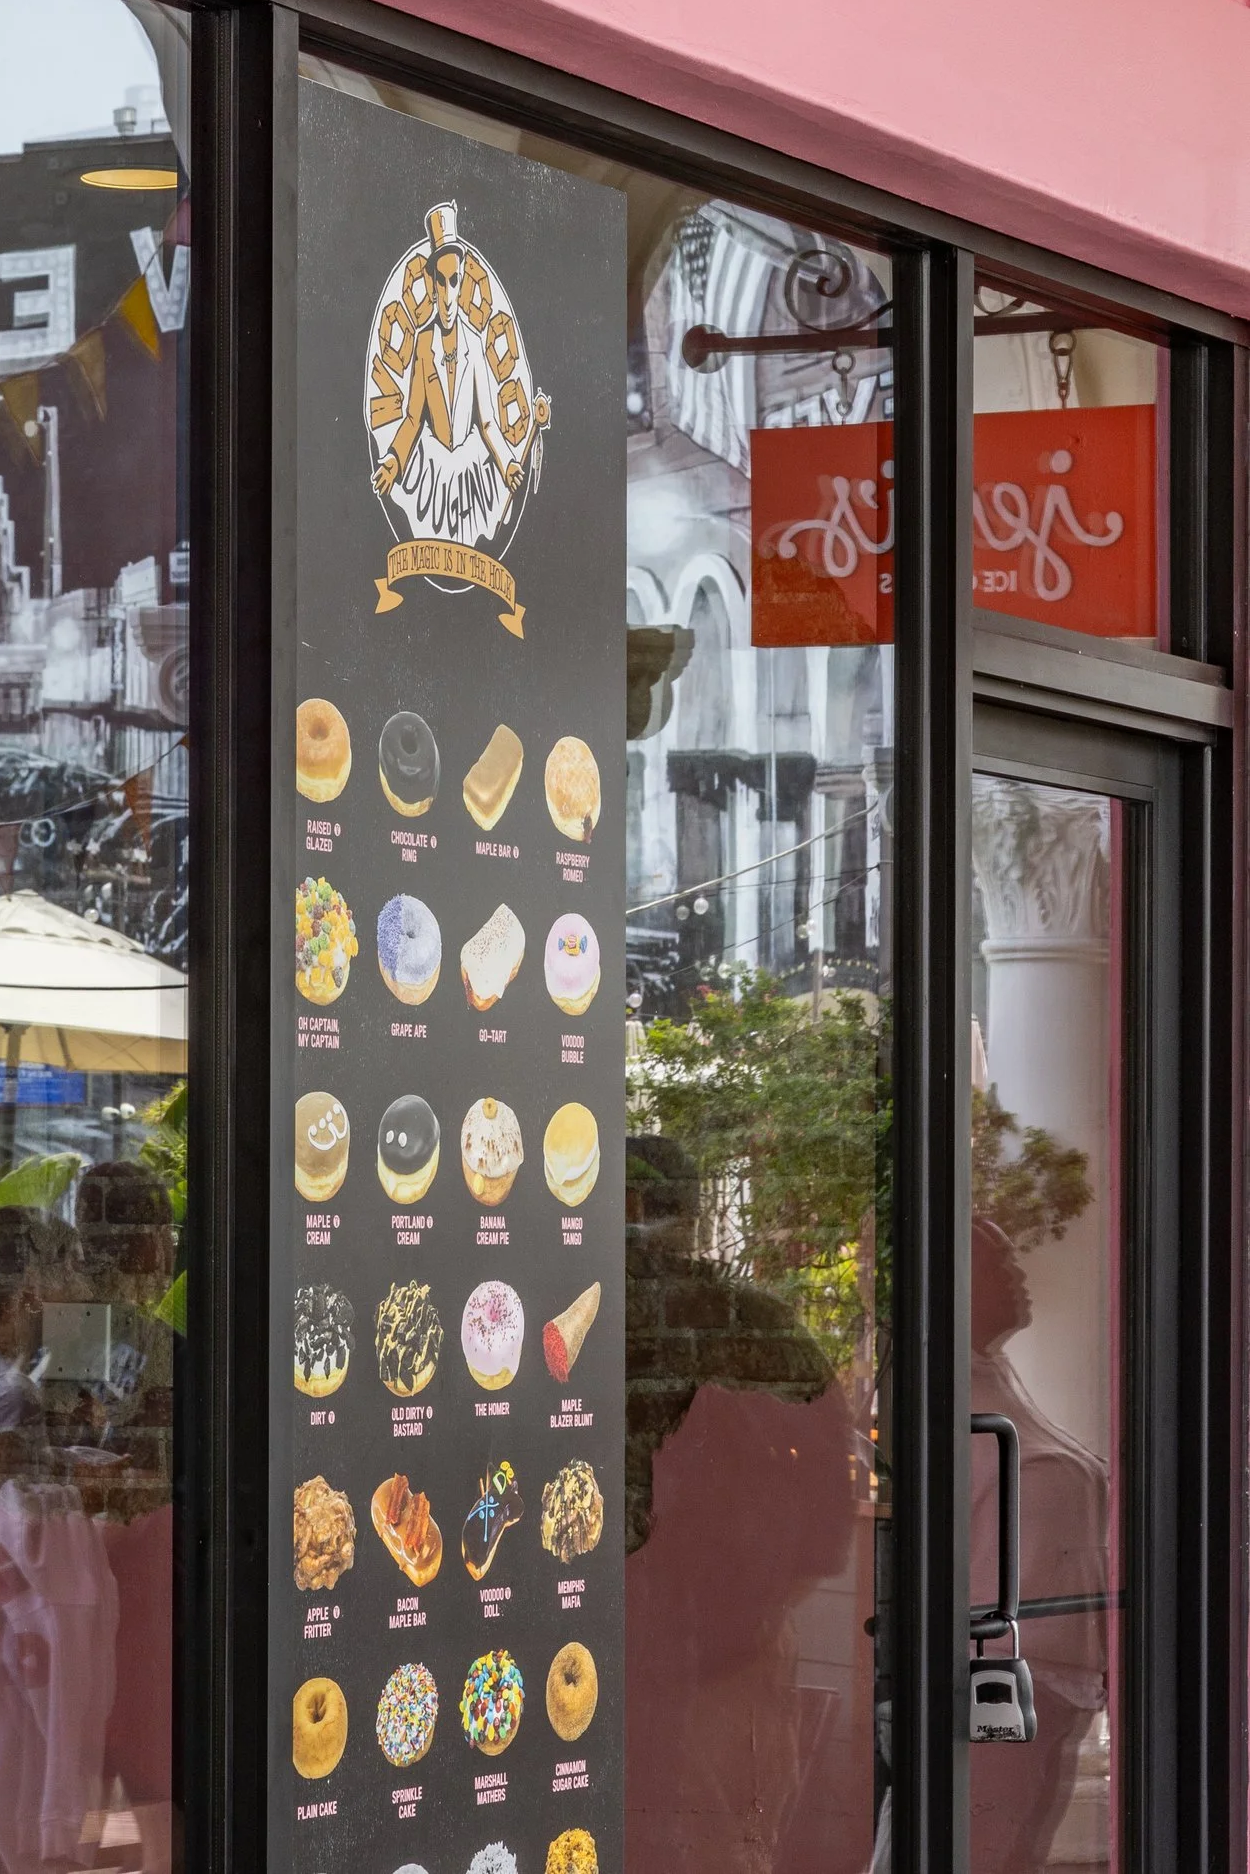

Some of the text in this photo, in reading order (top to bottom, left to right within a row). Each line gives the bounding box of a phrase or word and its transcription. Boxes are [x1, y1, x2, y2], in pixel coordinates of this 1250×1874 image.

[370, 252, 531, 448] VOODOO
[402, 438, 500, 543] DOUGHNUT
[390, 546, 513, 600] THE MAGIC IS IN THE HOLE
[307, 820, 332, 835] RAISED
[306, 836, 333, 852] GLAZED
[391, 831, 428, 848] CHOCOLATE
[402, 848, 417, 862] RING
[476, 842, 512, 859] MAPLE BAR
[556, 852, 590, 868] RASPBERRY
[563, 870, 583, 883] ROMEO
[298, 1017, 308, 1032] OH
[391, 1023, 427, 1038] GRAPE APE
[298, 1033, 340, 1049] MY CAPTAIN
[561, 1035, 584, 1048] VOODOO
[561, 1050, 584, 1064] BUBBLE
[306, 1215, 331, 1229] MAPLE
[391, 1216, 425, 1229] PORTLAND
[480, 1216, 506, 1229] BANANA
[561, 1217, 583, 1230] MANGO
[306, 1231, 331, 1245] CREAM
[397, 1232, 420, 1245] CREAM
[476, 1232, 510, 1245] CREAM PIE
[563, 1233, 582, 1245] TANGO
[475, 1402, 510, 1417] THE HOMER
[561, 1399, 582, 1412] MAPLE
[310, 1411, 326, 1425] DIRT
[391, 1407, 425, 1421] OLD DIRTY
[550, 1414, 593, 1428] BLAZER BLUNT
[393, 1422, 423, 1437] BASTARD
[558, 1580, 585, 1594] MEMPHIS
[479, 1588, 504, 1603] VOODOO
[561, 1595, 581, 1609] MAFIA
[397, 1597, 419, 1612] BACON
[484, 1604, 500, 1618] DOLL
[307, 1607, 329, 1622] APPLE
[389, 1612, 427, 1629] MAPLE BAR
[304, 1622, 332, 1639] FRITTER
[555, 1760, 586, 1776] CINNAMON
[474, 1773, 508, 1789] MARSHALL
[552, 1774, 589, 1792] SUGAR CAKE
[392, 1787, 422, 1804] SPRINKLE
[477, 1789, 506, 1805] MATHERS
[297, 1800, 337, 1820] PLAIN CAKE
[398, 1803, 416, 1819] CAKE
